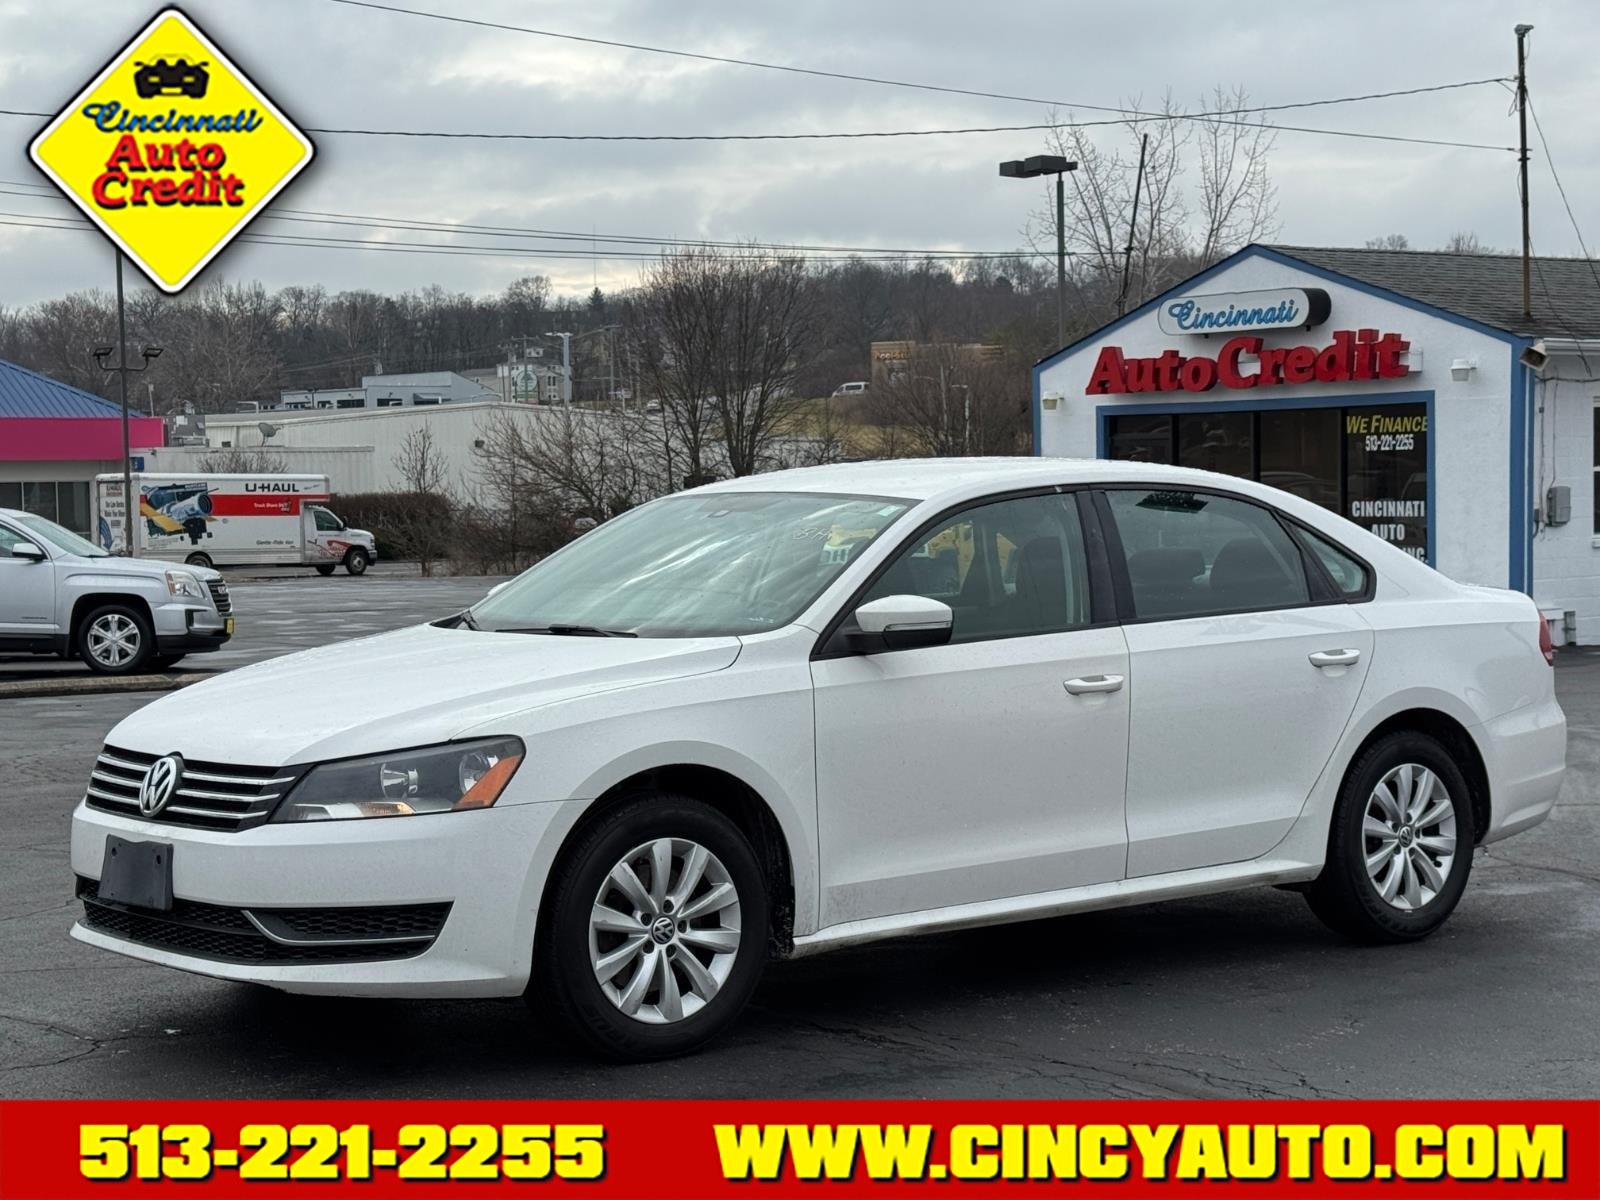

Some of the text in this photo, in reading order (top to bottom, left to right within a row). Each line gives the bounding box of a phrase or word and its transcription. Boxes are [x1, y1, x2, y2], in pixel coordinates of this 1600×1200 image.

[1168, 299, 1299, 330] Cincinnati
[1365, 434, 1415, 451] 513-221-2255
[245, 483, 300, 492] U-HAUL
[1352, 500, 1425, 518] CINCINNATI
[1371, 524, 1405, 540] AUTO
